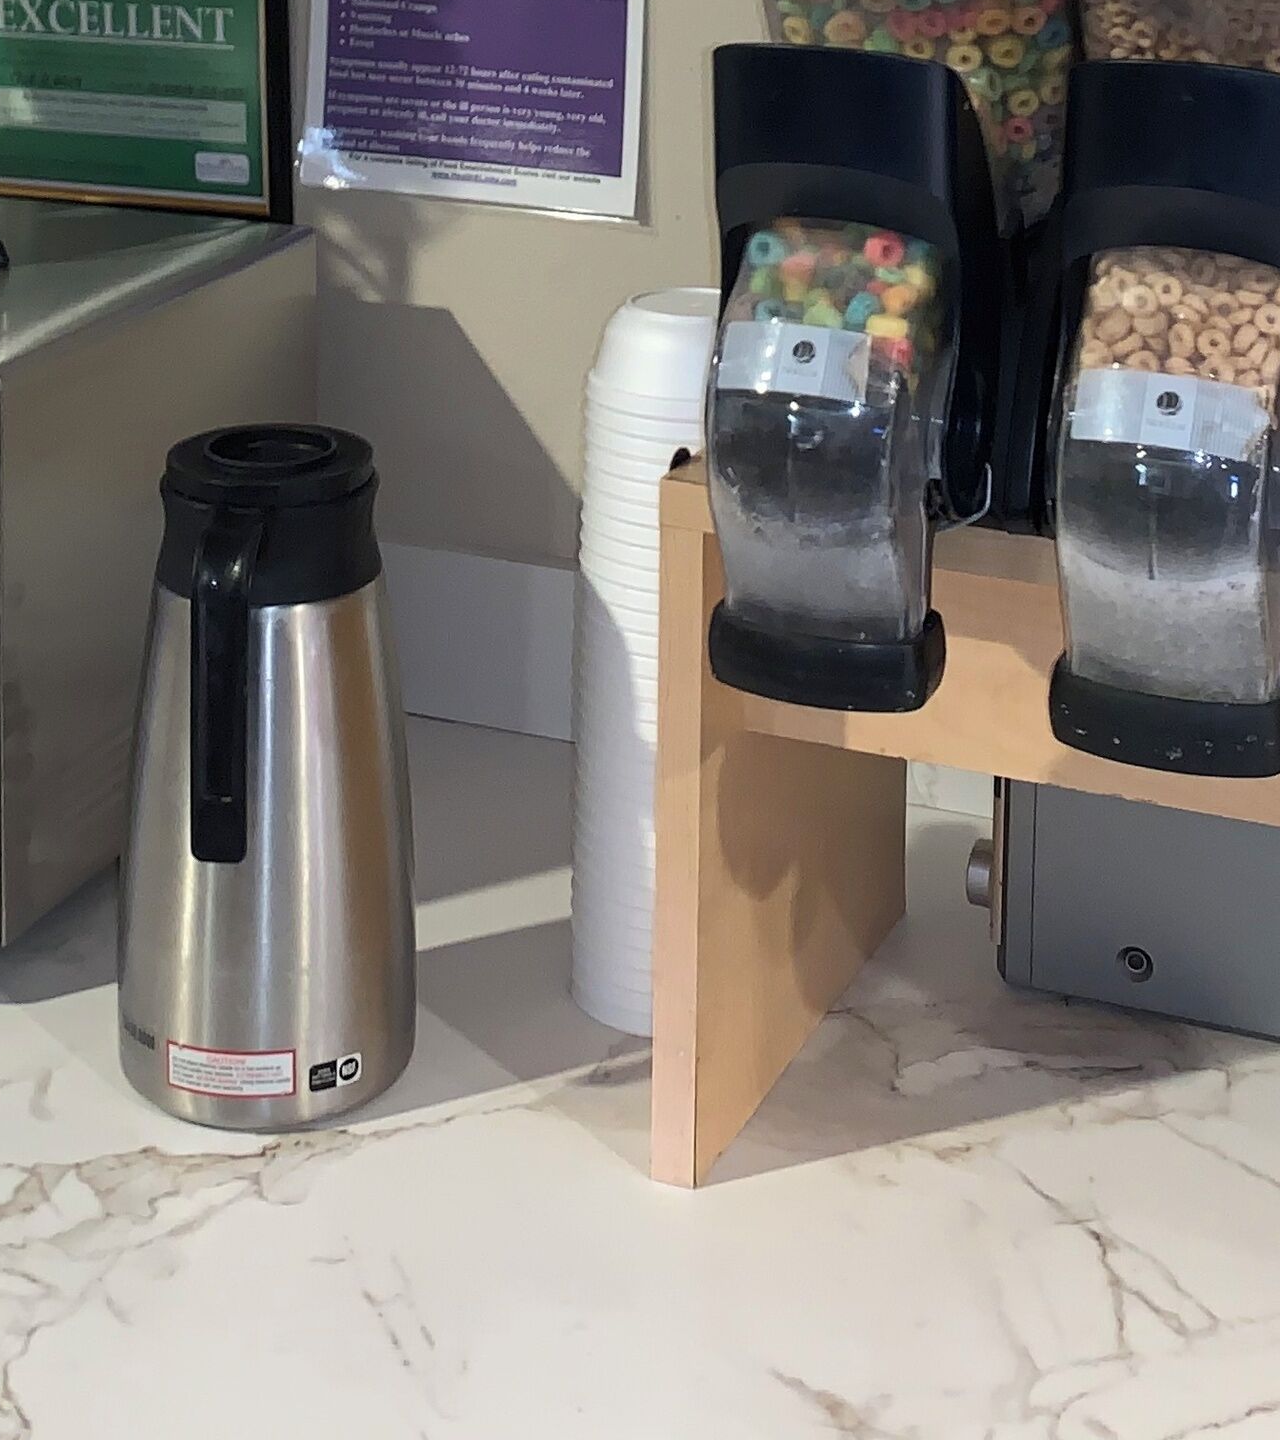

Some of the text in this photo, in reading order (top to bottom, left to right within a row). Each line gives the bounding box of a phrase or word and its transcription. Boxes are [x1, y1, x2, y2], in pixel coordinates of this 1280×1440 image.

[470, 65, 497, 78] hours
[498, 69, 520, 80] after
[522, 72, 550, 86] eating
[552, 76, 614, 89] contaminated
[467, 80, 503, 92] minutes
[531, 87, 559, 97] weeks
[443, 100, 457, 110] the
[470, 104, 501, 114] person
[502, 105, 510, 113] is
[512, 107, 532, 118] very
[566, 112, 586, 124] very
[588, 113, 607, 126] old,
[471, 115, 501, 126] doctor
[470, 137, 515, 151] frequently
[518, 140, 542, 154] helps
